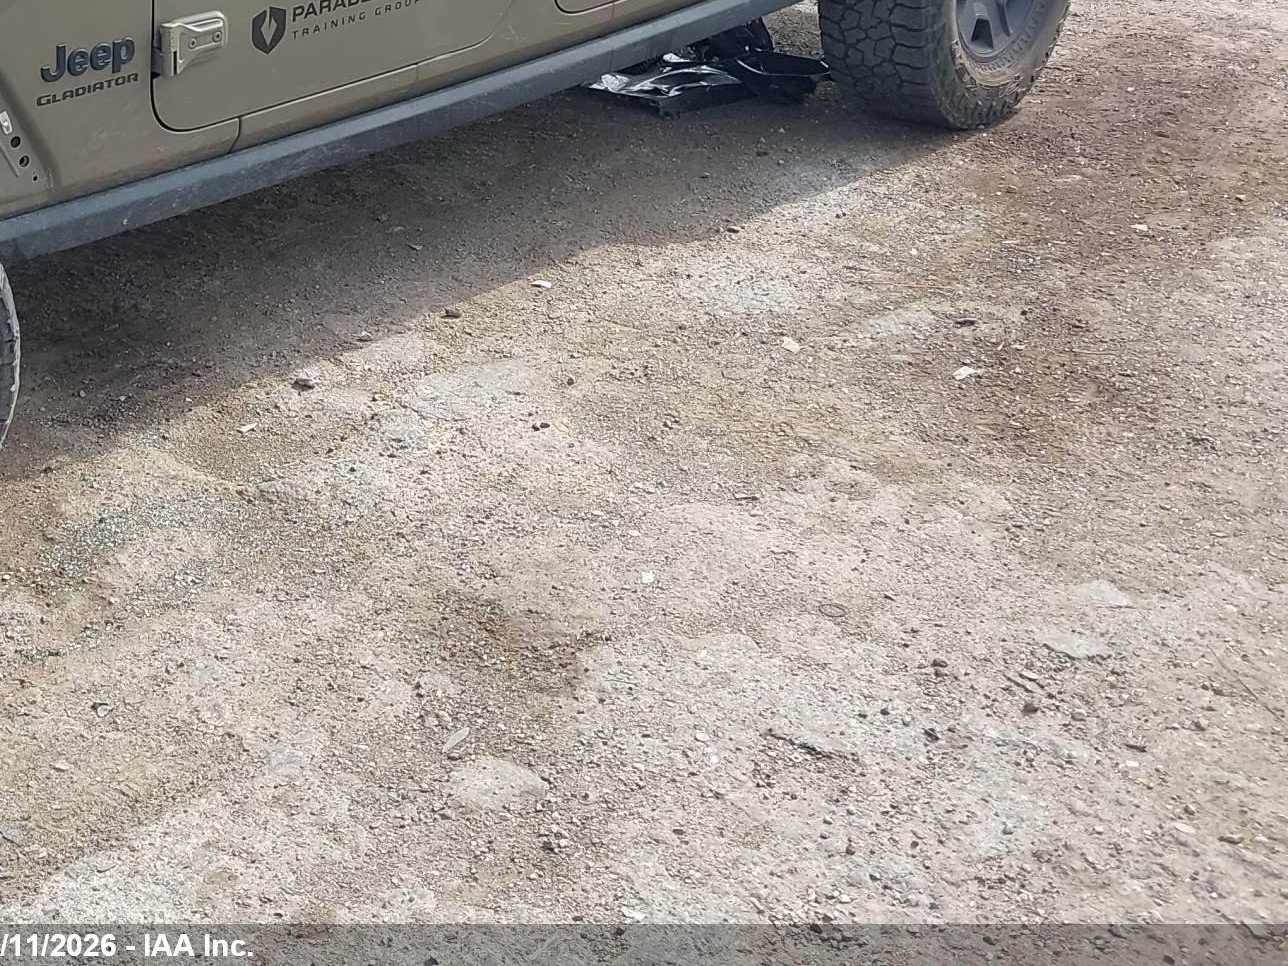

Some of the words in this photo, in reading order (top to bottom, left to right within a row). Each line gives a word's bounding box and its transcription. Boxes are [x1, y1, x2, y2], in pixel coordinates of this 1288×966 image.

[292, 12, 366, 39] TRAINING
[40, 37, 135, 83] Jeep
[36, 72, 139, 106] GLADIATOR
